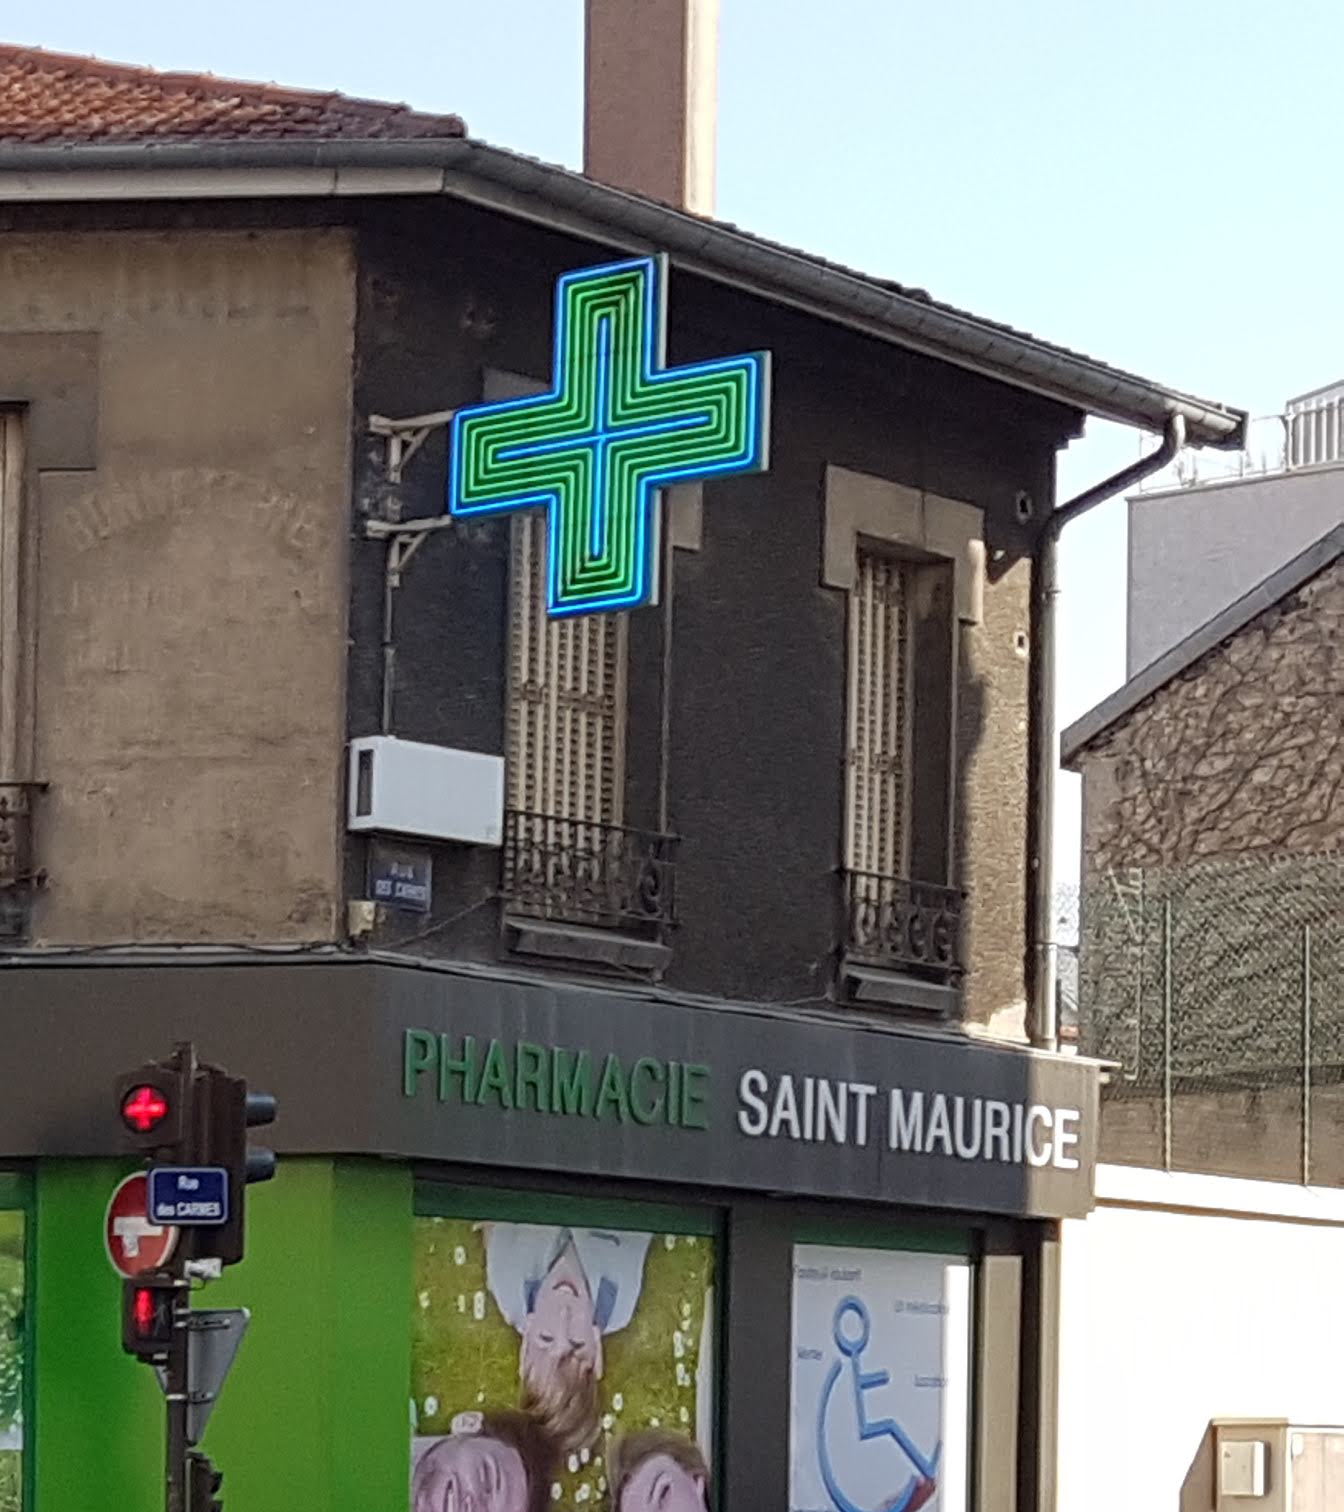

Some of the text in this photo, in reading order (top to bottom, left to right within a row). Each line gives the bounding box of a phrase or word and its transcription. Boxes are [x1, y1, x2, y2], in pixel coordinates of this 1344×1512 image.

[404, 1028, 1081, 1171] PHARMACIE SAINT MAURICE
